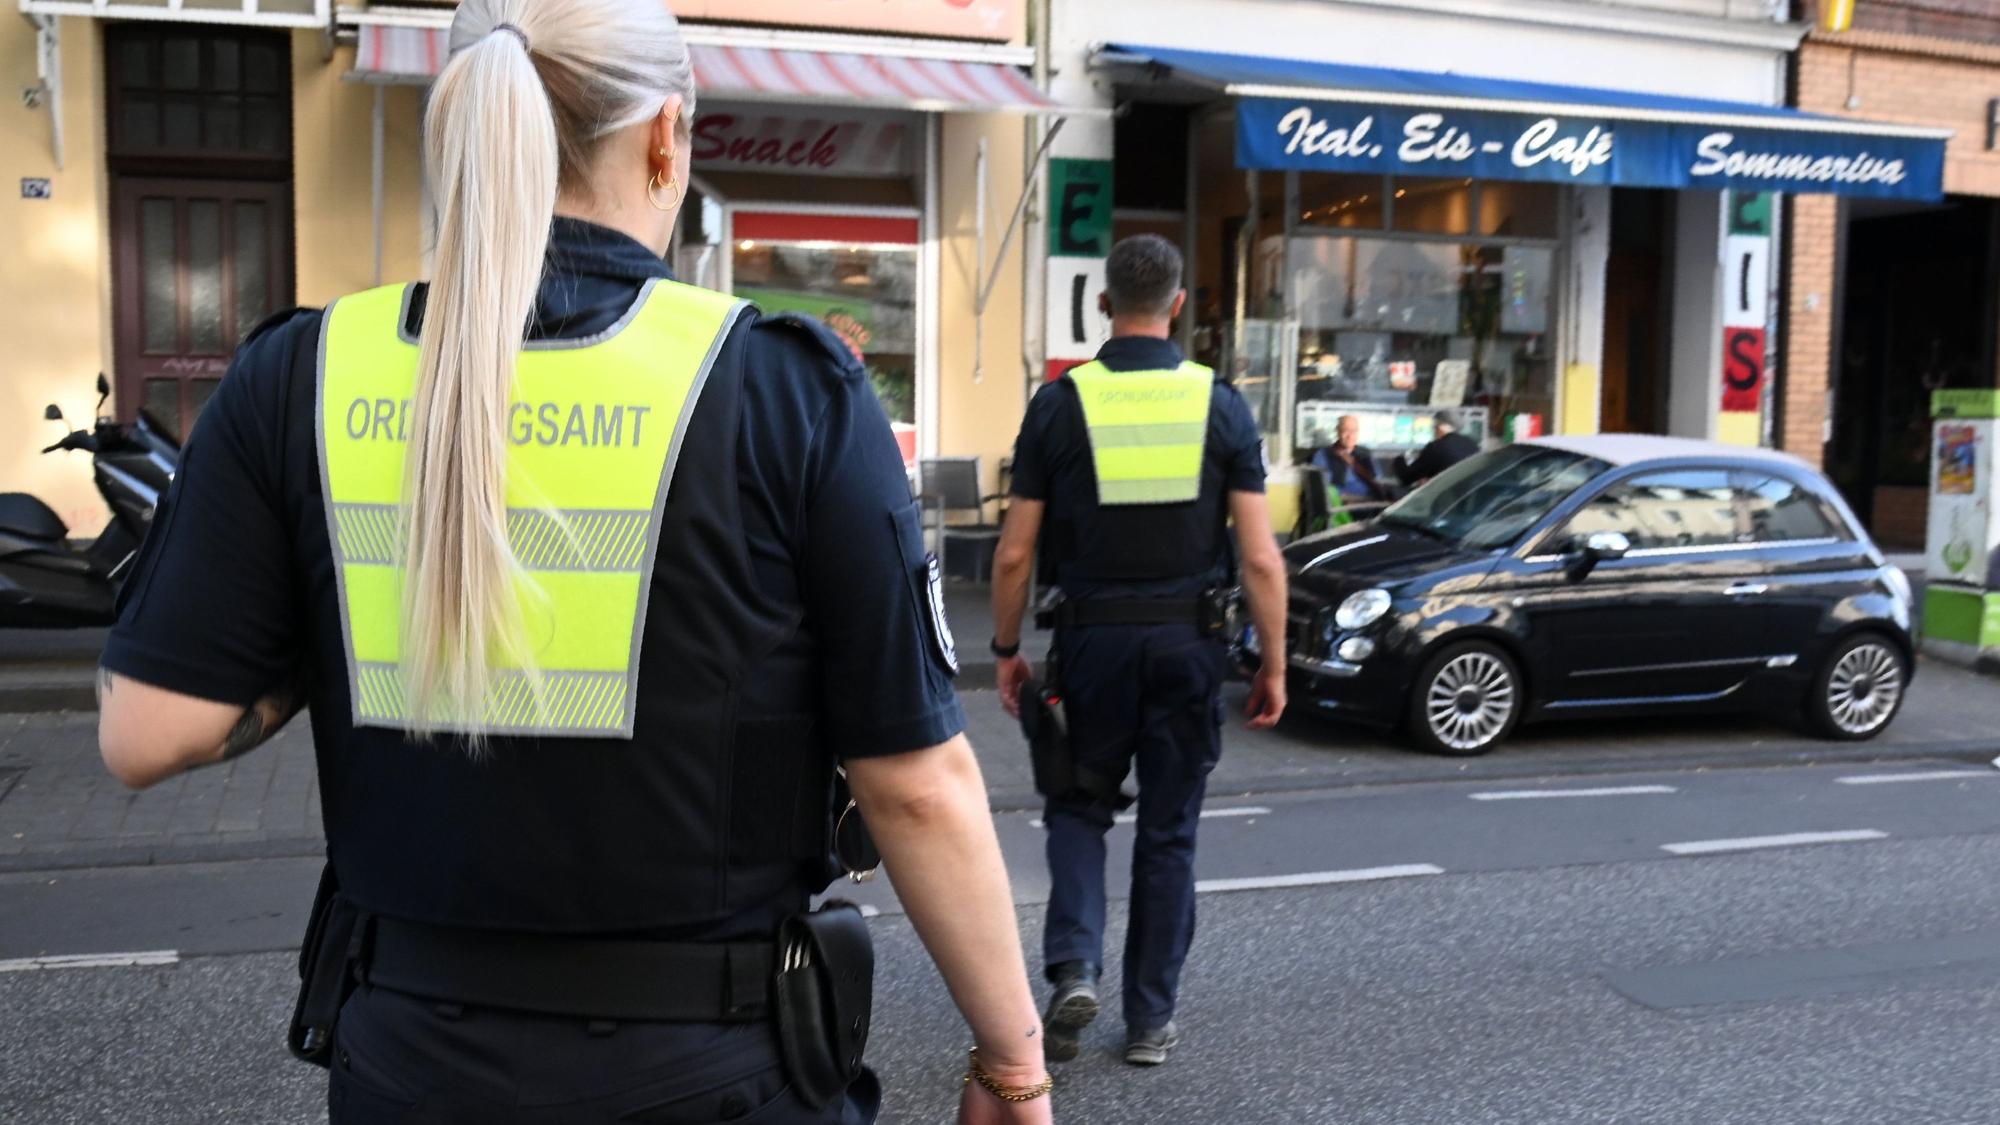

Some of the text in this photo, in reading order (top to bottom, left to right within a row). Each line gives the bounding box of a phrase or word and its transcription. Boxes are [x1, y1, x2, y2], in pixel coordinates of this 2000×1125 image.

[691, 112, 840, 168] Snack
[1277, 106, 1383, 159] Ital.
[1690, 131, 1907, 185] Sommariva
[346, 397, 651, 447] ORGSAMT
